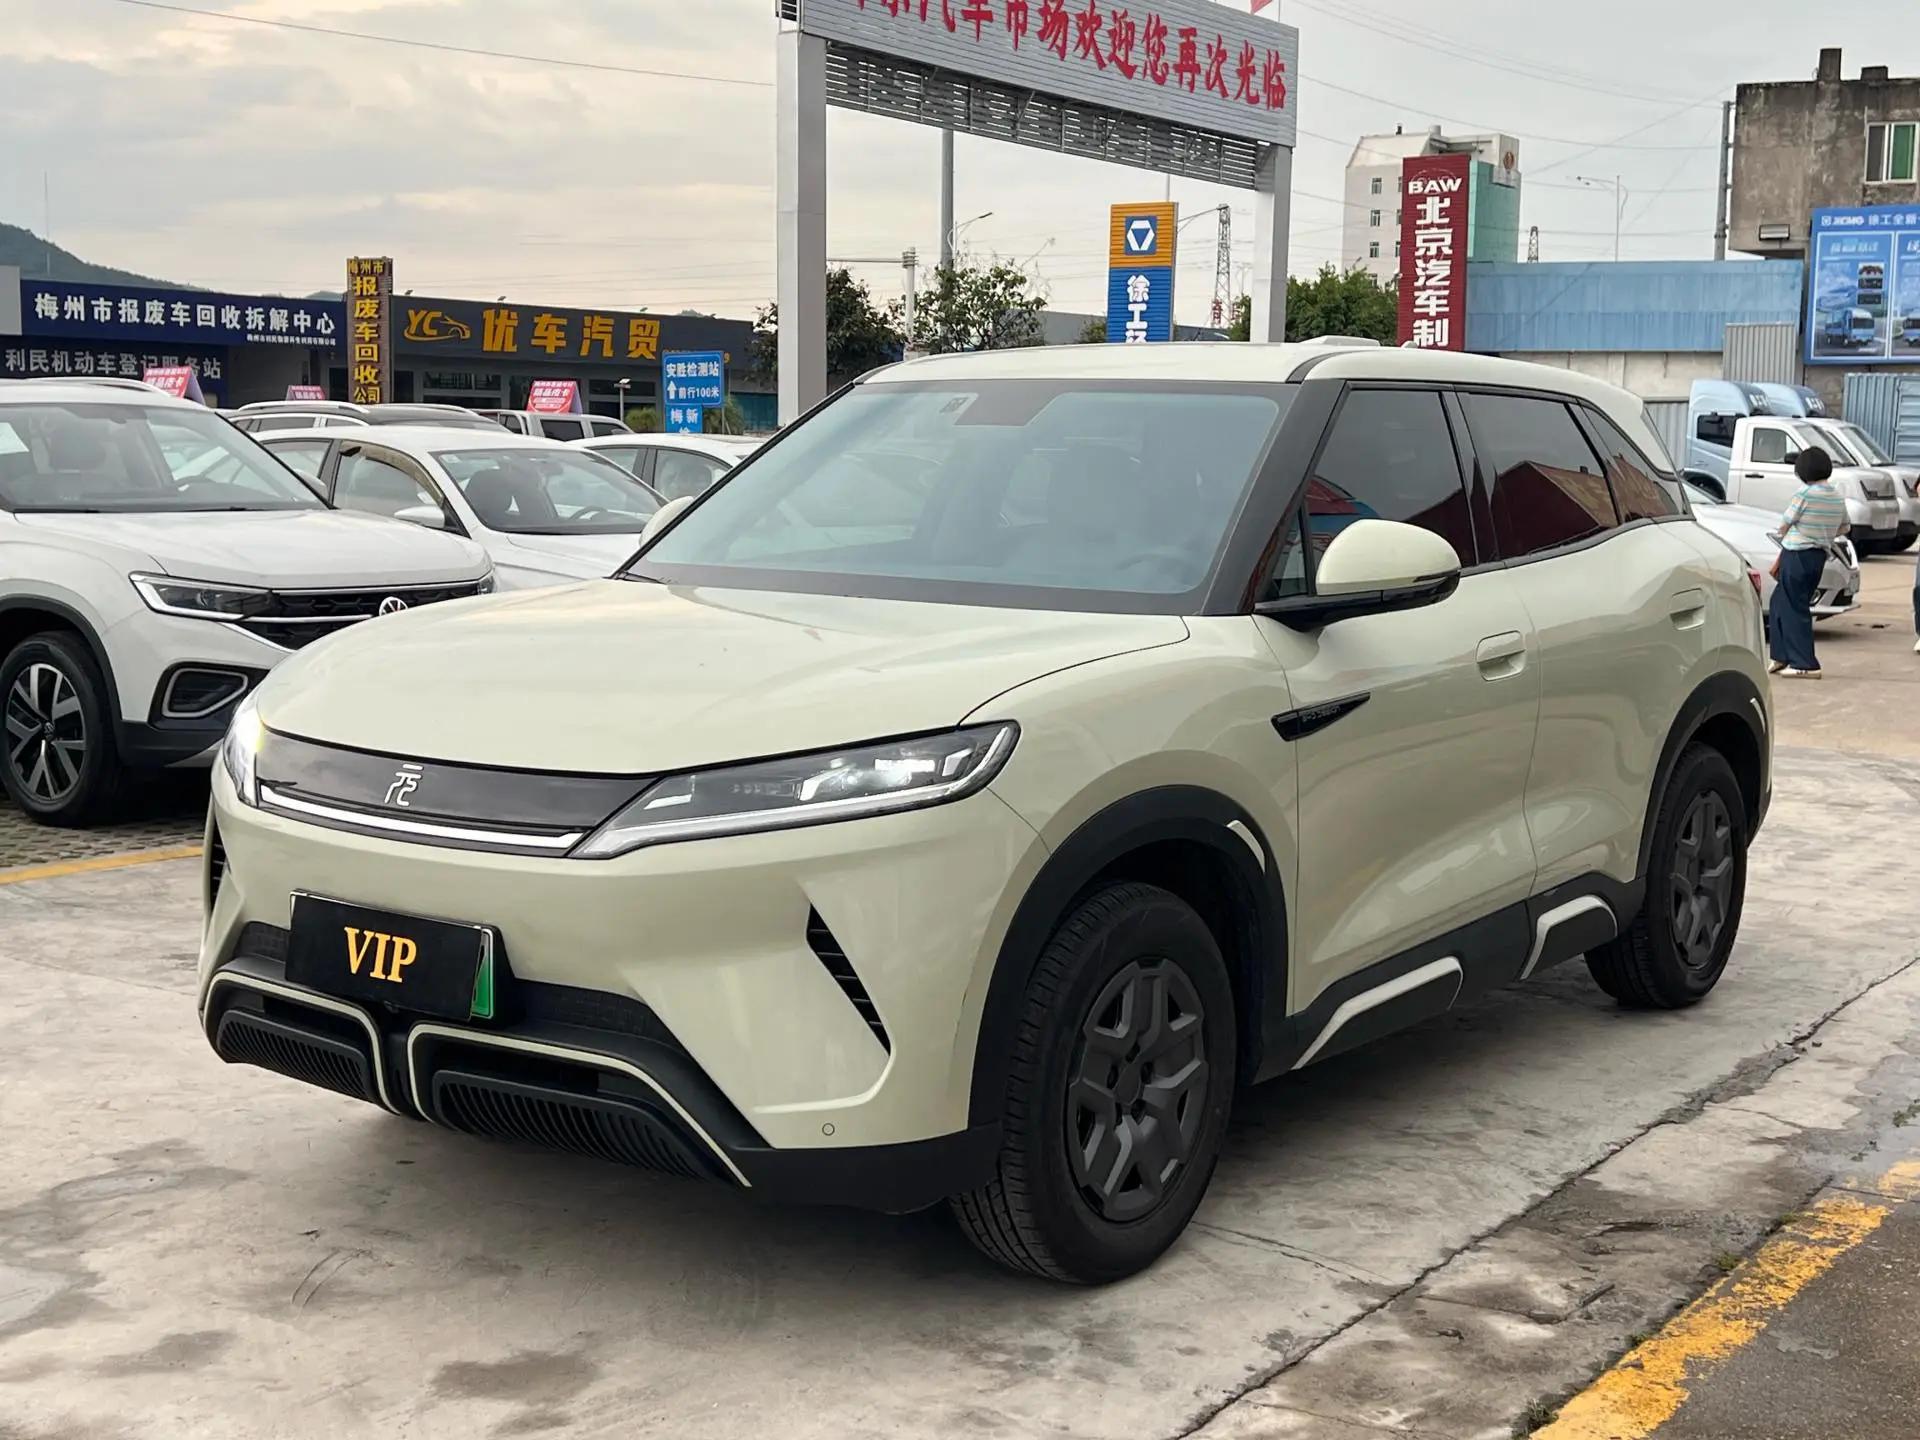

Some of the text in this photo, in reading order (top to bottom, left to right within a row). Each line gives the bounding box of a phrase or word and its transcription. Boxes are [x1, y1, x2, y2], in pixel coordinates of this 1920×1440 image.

[858, 0, 1286, 111] 车市场欢迎您再次光临
[1408, 178, 1462, 194] BAW
[34, 293, 336, 335] 梅州市报废车回收拆解中心
[407, 310, 442, 336] YC
[483, 309, 660, 360] 优车汽贸
[666, 361, 719, 377] 安胜检测站
[678, 386, 720, 399] 前行100米
[384, 763, 424, 807] 元
[343, 926, 417, 983] VIP
